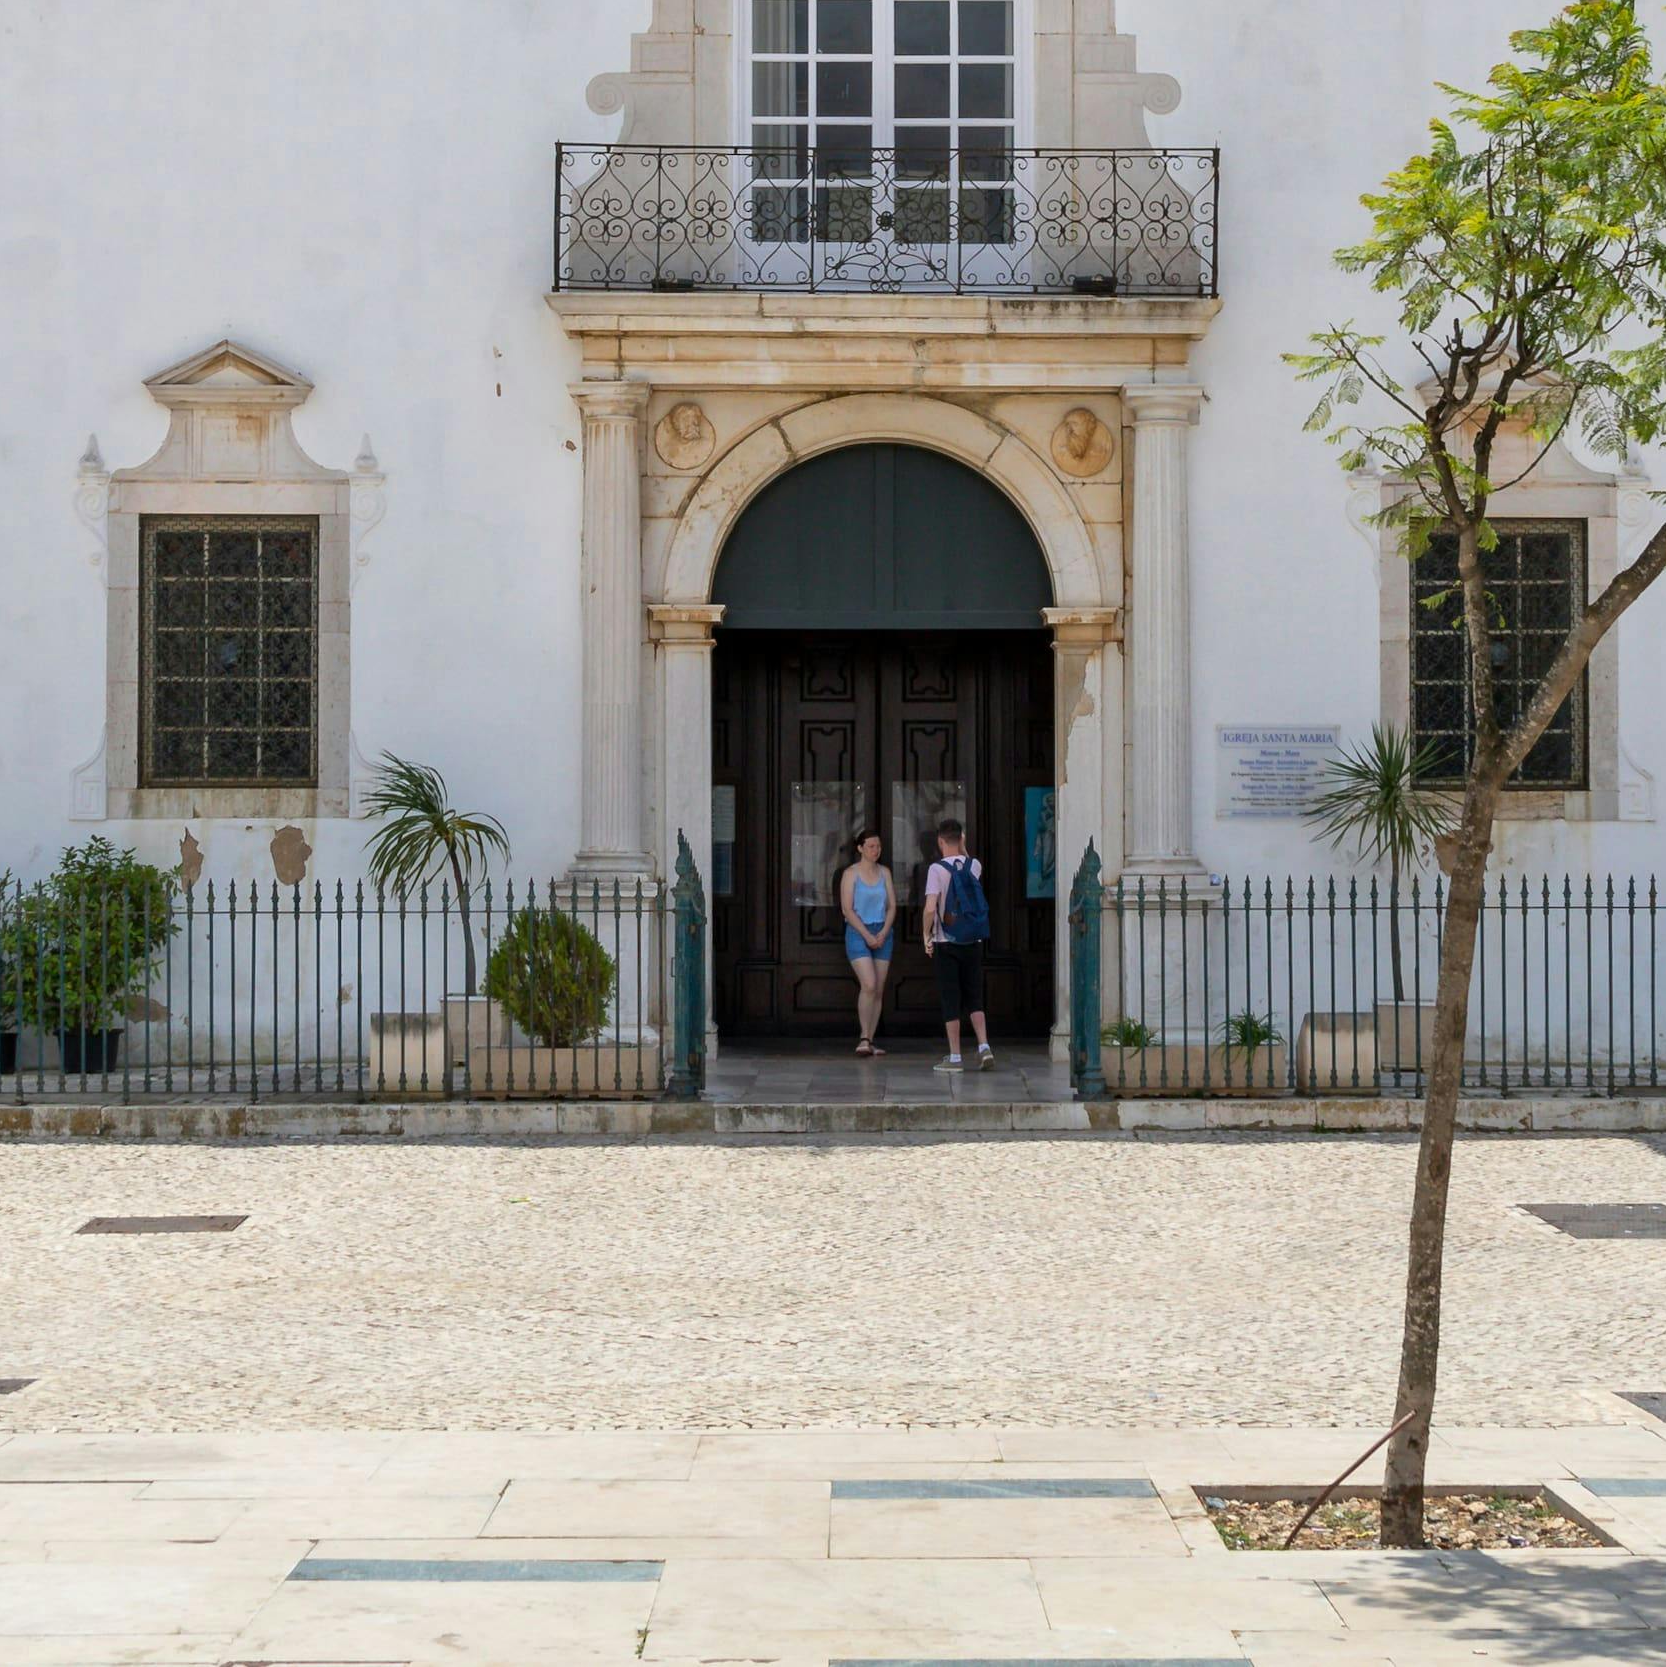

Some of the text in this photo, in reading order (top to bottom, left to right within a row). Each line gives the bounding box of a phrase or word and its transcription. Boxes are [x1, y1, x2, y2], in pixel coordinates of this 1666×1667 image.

[1223, 733, 1333, 744] IGREJA SANTA MARIA
